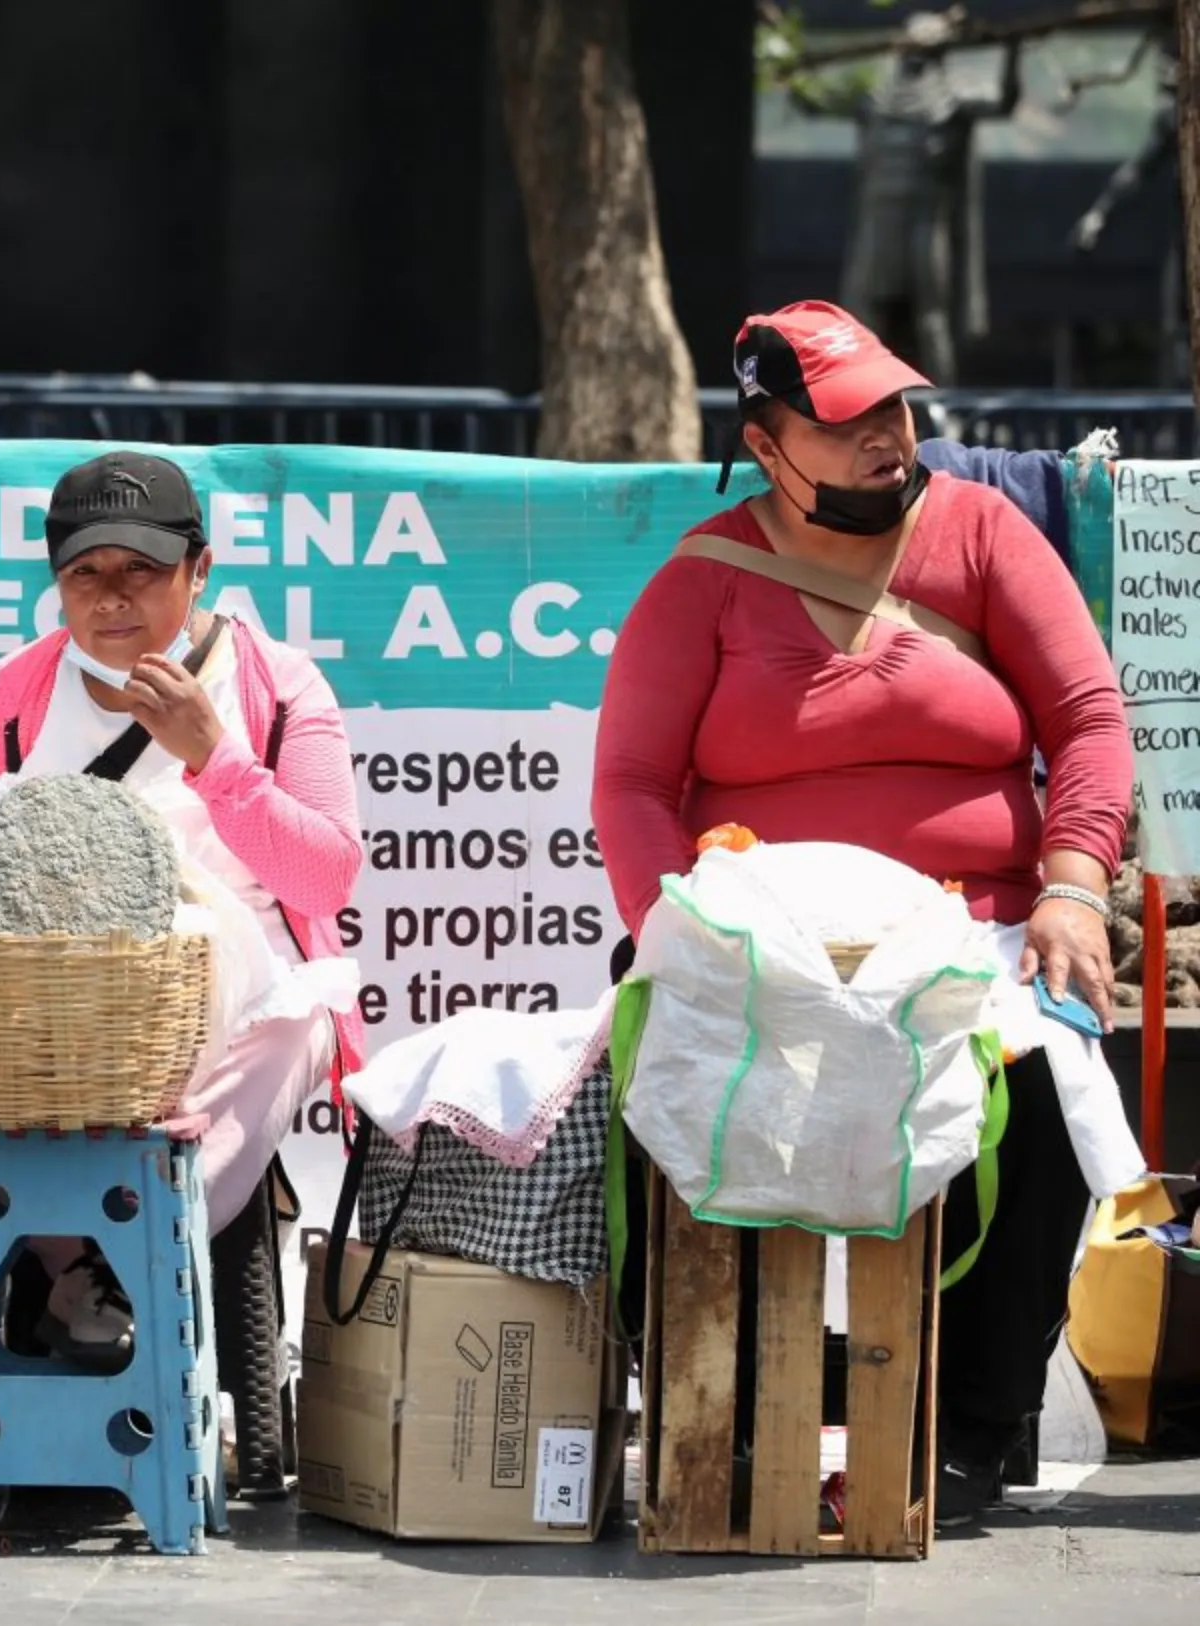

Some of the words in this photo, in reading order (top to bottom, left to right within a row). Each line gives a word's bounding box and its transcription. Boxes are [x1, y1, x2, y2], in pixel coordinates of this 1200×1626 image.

[383, 581, 615, 660] A.C.
[1121, 607, 1187, 641] nales
[386, 892, 603, 960] propias
[503, 1329, 529, 1368] Base
[500, 1373, 527, 1425] Helado
[557, 1485, 572, 1507] 87
